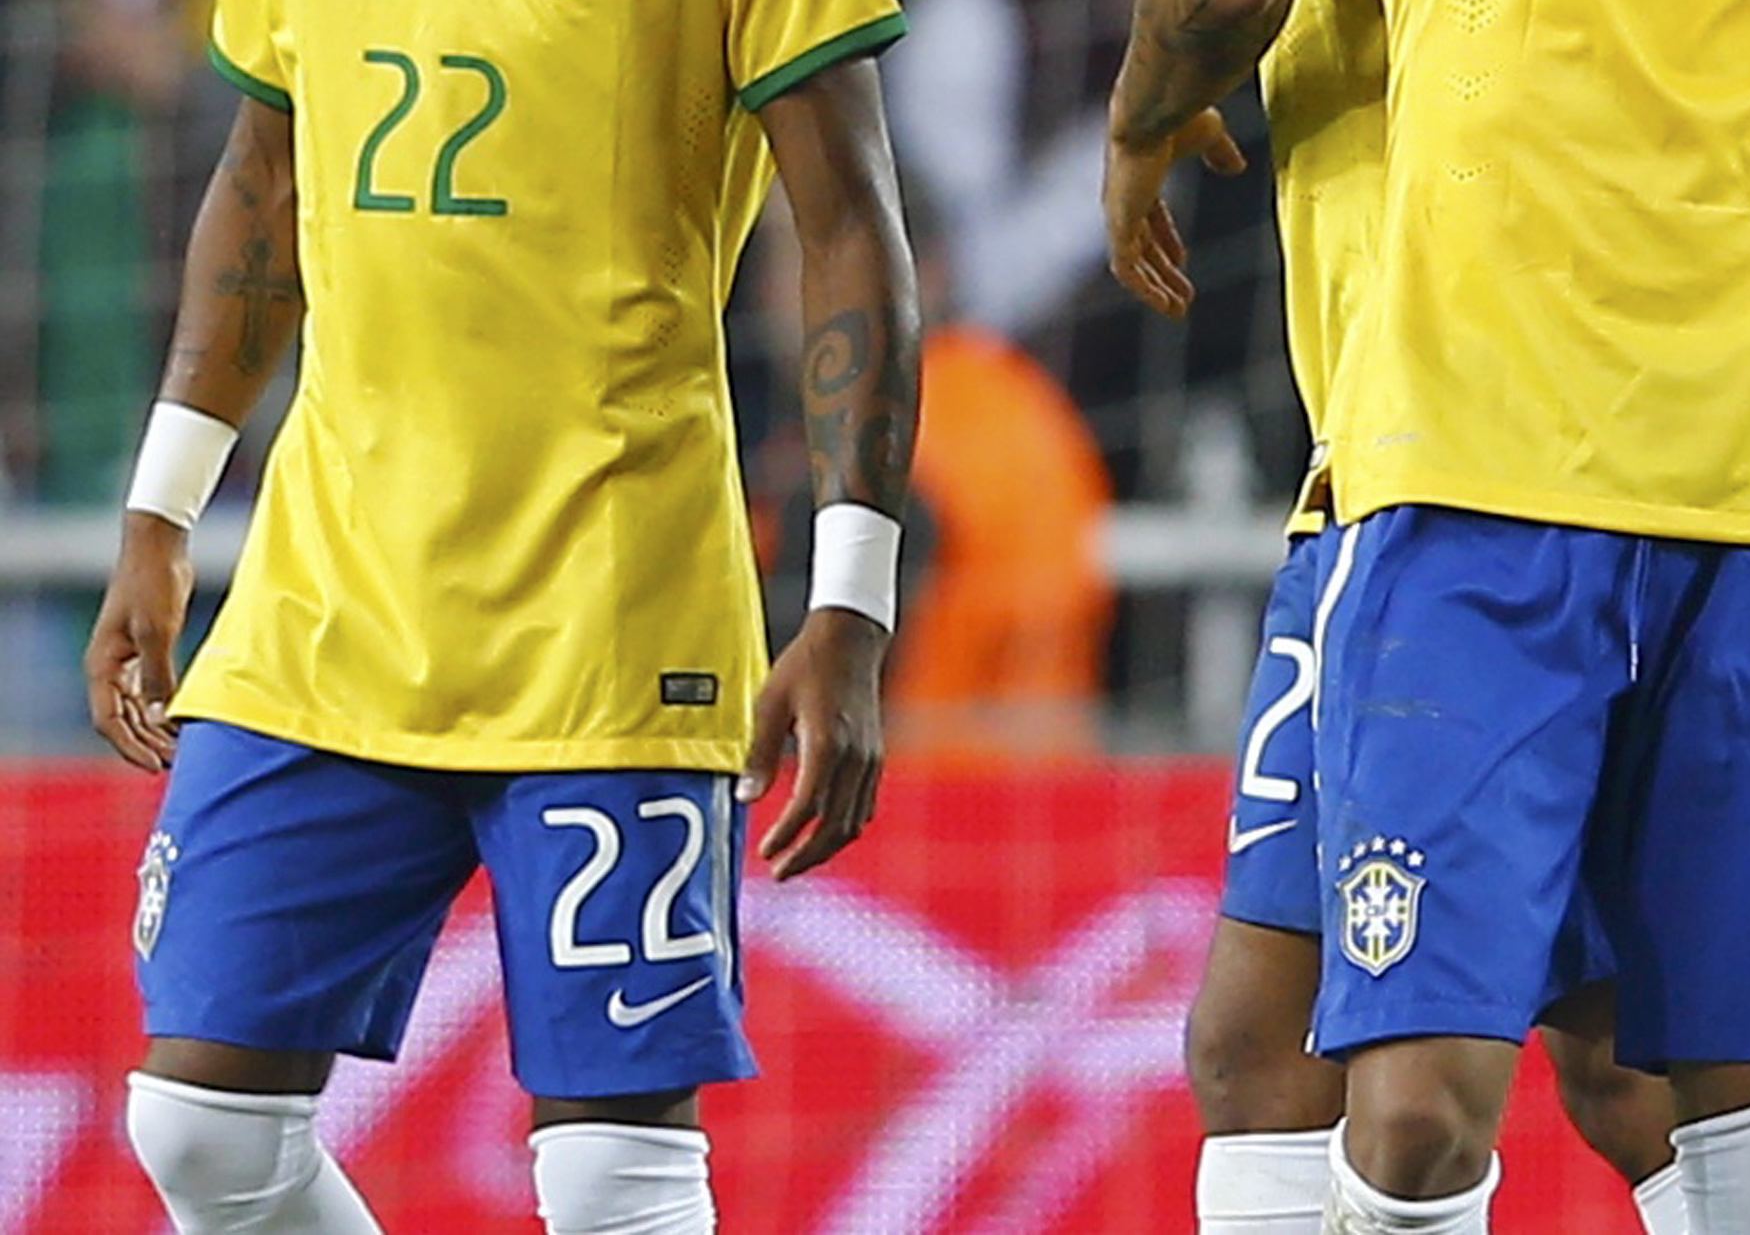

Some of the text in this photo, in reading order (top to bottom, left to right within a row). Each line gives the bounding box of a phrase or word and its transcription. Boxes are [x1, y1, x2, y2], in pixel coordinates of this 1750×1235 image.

[353, 49, 508, 217] 22
[1240, 635, 1316, 803] 2
[542, 797, 715, 968] 22
